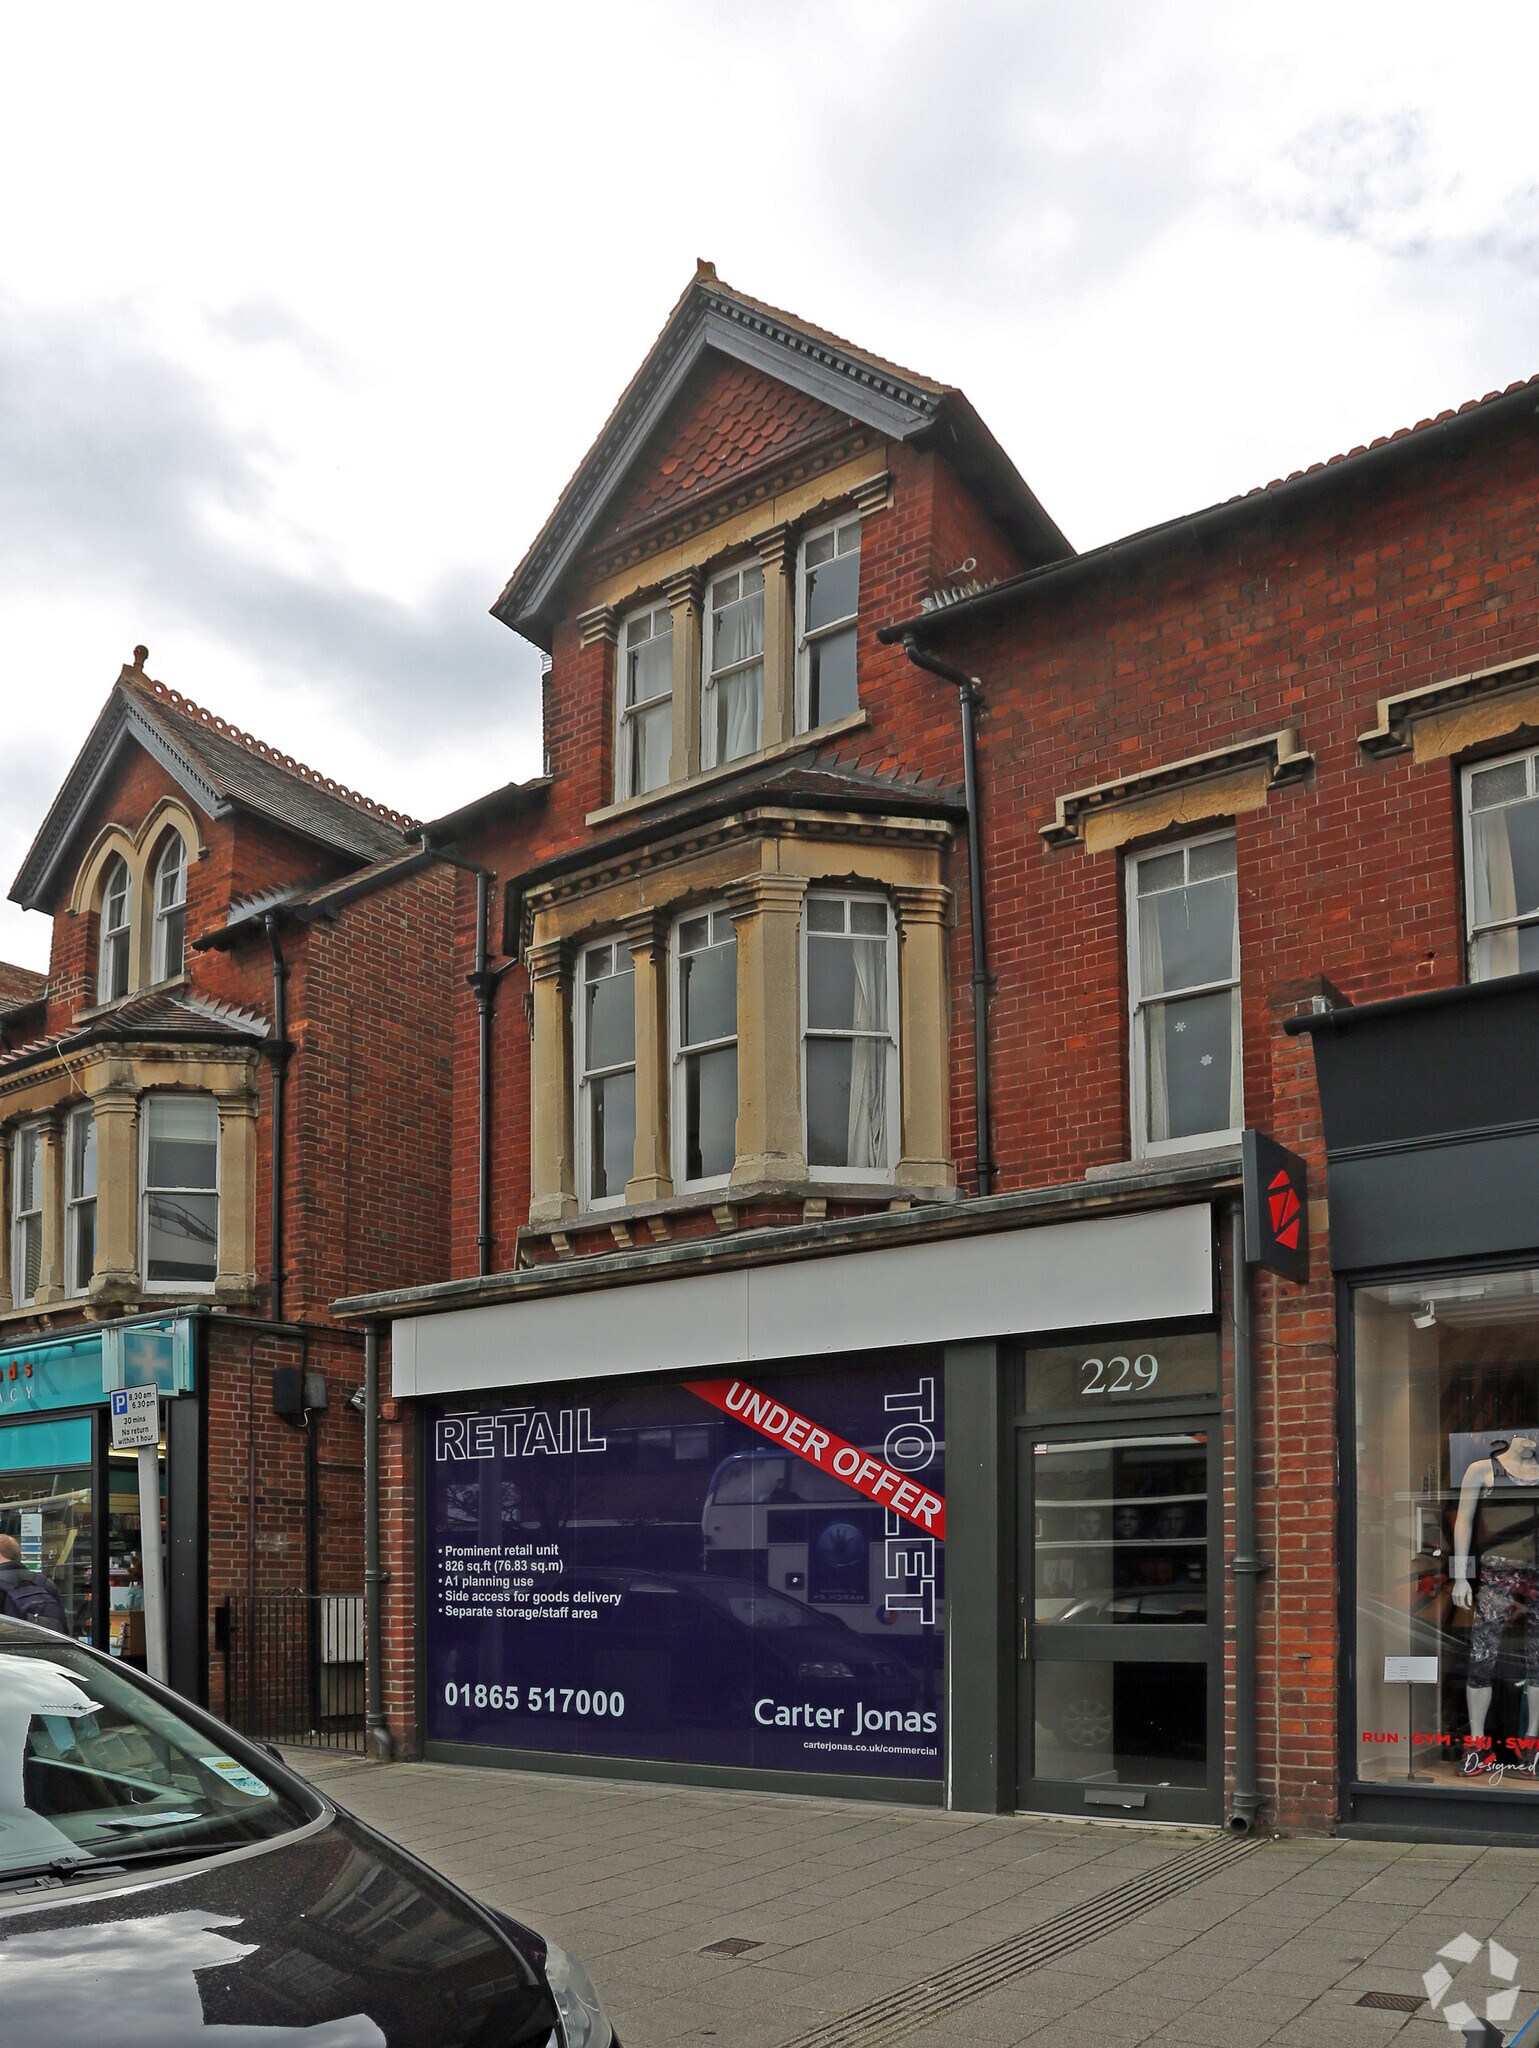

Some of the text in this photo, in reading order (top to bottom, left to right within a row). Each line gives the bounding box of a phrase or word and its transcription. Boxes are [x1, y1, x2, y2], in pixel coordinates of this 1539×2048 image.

[1081, 1353, 1159, 1394] 229
[128, 1392, 142, 1401] 8.30
[131, 1400, 155, 1409] 6.30 pm
[123, 1416, 146, 1425] 30 mins
[884, 1377, 936, 1472] TO
[121, 1426, 149, 1436] No return
[436, 1408, 606, 1461] RETAIL
[118, 1437, 135, 1445] within
[140, 1434, 153, 1442] hour
[725, 1382, 942, 1528] UNDER OFFER
[445, 1544, 559, 1557] Prominent retail unit
[445, 1560, 563, 1573] 826 sq.ft (76.83 sq.m)
[445, 1575, 534, 1589] A1 planning use
[445, 1590, 622, 1606] Side access for goods delivery
[445, 1605, 598, 1620] Separate storage/staff area
[444, 1682, 625, 1717] 01865 517000
[754, 1698, 937, 1736] Carter Jonas
[1362, 1732, 1399, 1744] RUN
[1411, 1733, 1451, 1746] GYM
[1463, 1735, 1492, 1749] SKI
[803, 1741, 937, 1756] carterjonas.co.uk/commercial
[1463, 1752, 1539, 1786] Designed
